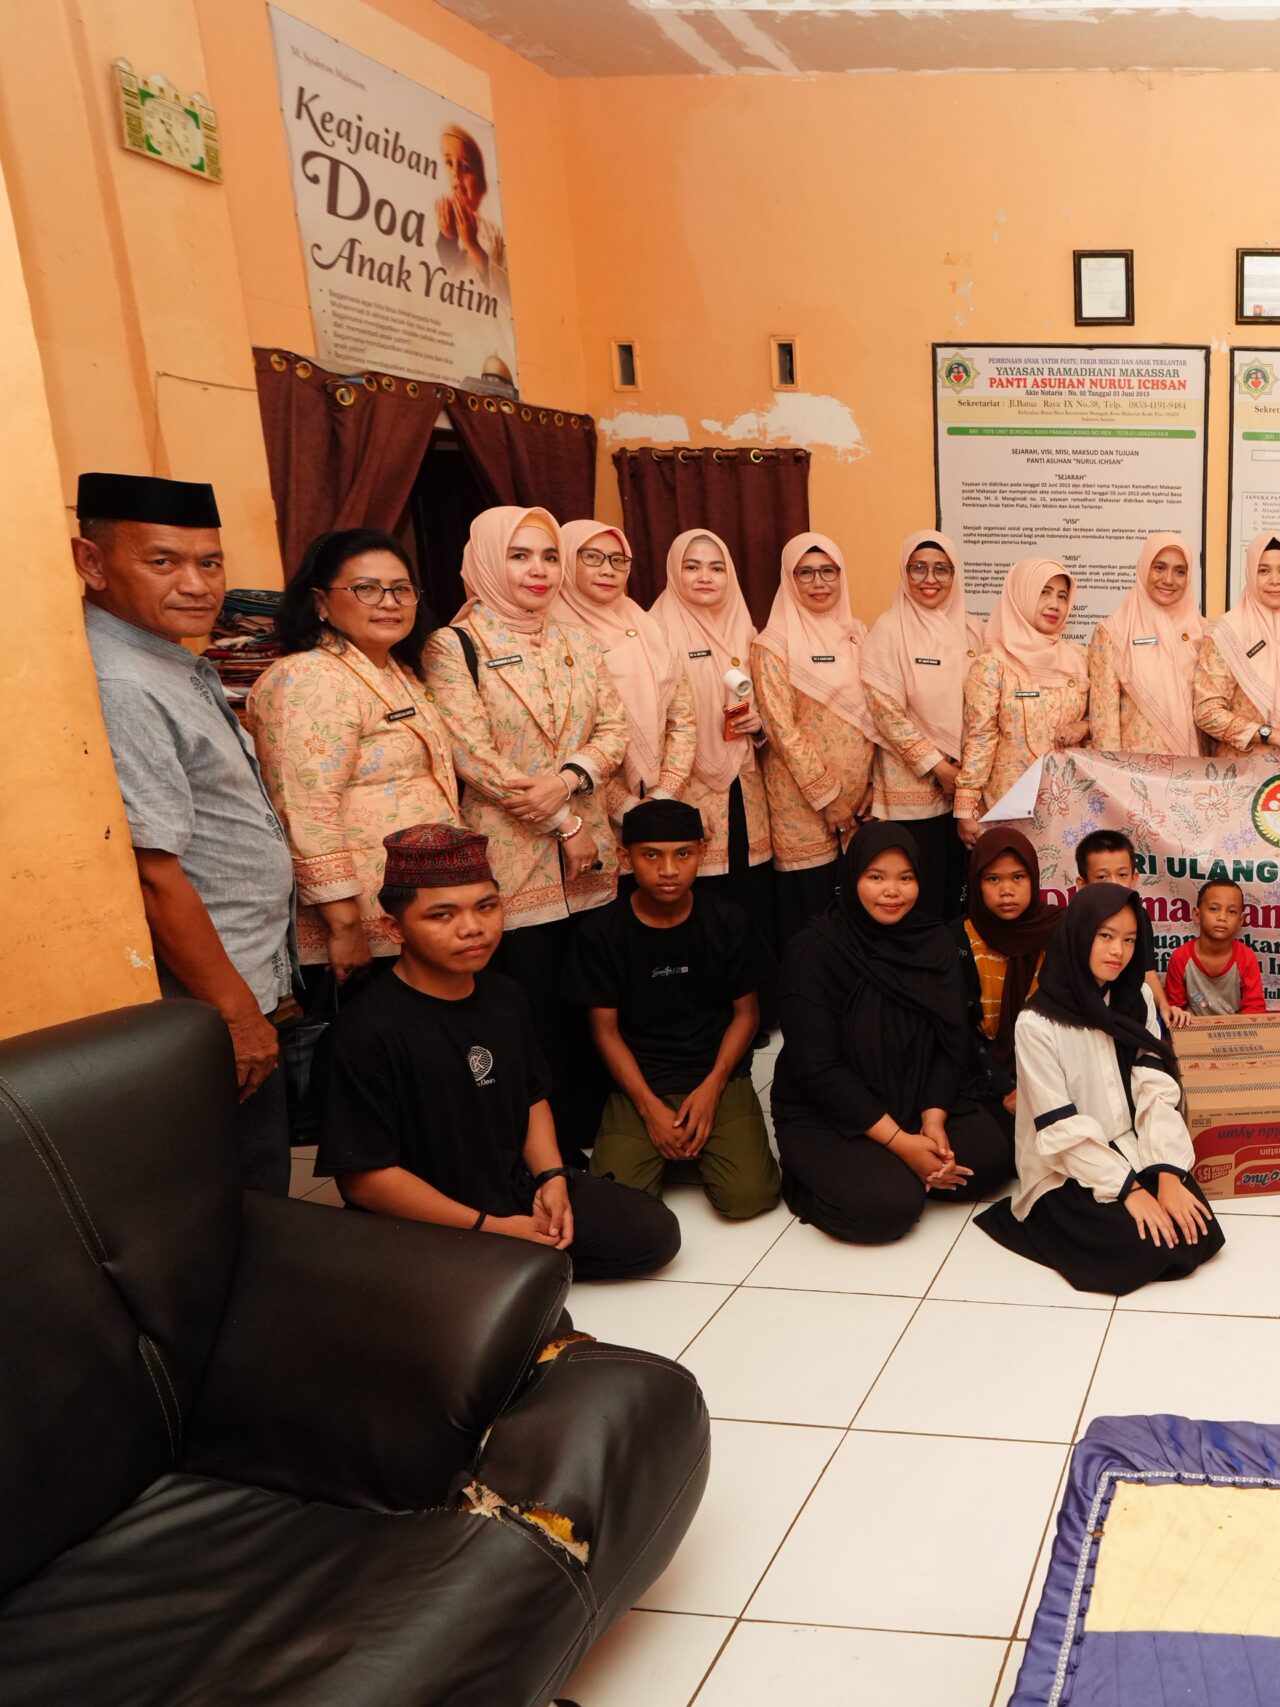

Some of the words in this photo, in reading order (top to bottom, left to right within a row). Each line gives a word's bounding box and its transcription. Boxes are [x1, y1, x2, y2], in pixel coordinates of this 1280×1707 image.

[295, 86, 438, 180] Keajaiban
[301, 150, 425, 248] Doa
[311, 238, 412, 292] Anak
[419, 260, 498, 318] Yatim
[988, 377, 1027, 388] PANTI
[1030, 378, 1085, 390] ASUHAN
[1088, 378, 1134, 390] NURUL
[1137, 378, 1187, 391] ICHSAN
[995, 366, 1044, 377] YAYASAN
[1047, 367, 1116, 378] RAMADHANI
[1118, 368, 1180, 379] MAKASSAR
[1042, 399, 1060, 407] Raya
[1063, 399, 1073, 407] IX
[1134, 853, 1157, 875] RI
[1166, 856, 1279, 883] ULANG
